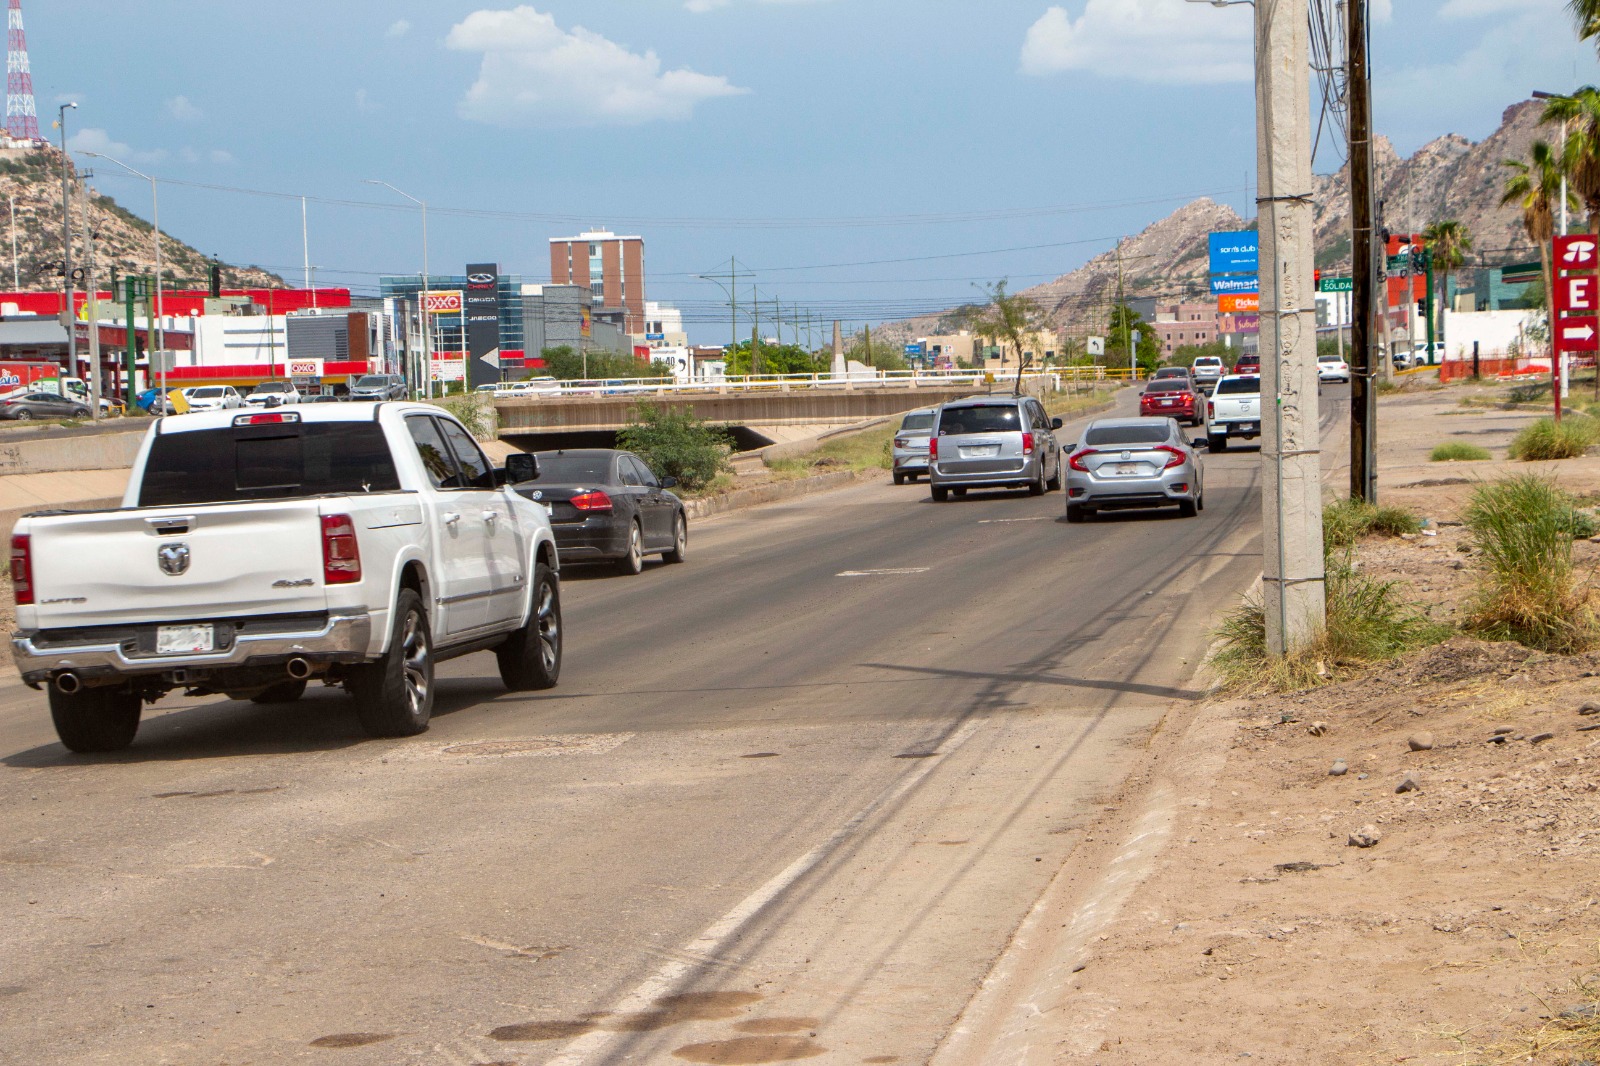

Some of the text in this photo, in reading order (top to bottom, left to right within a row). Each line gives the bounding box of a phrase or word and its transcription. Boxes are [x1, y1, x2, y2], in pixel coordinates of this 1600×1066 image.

[1213, 279, 1258, 290] Walmart
[1569, 278, 1590, 308] E
[292, 364, 315, 372] OXXO
